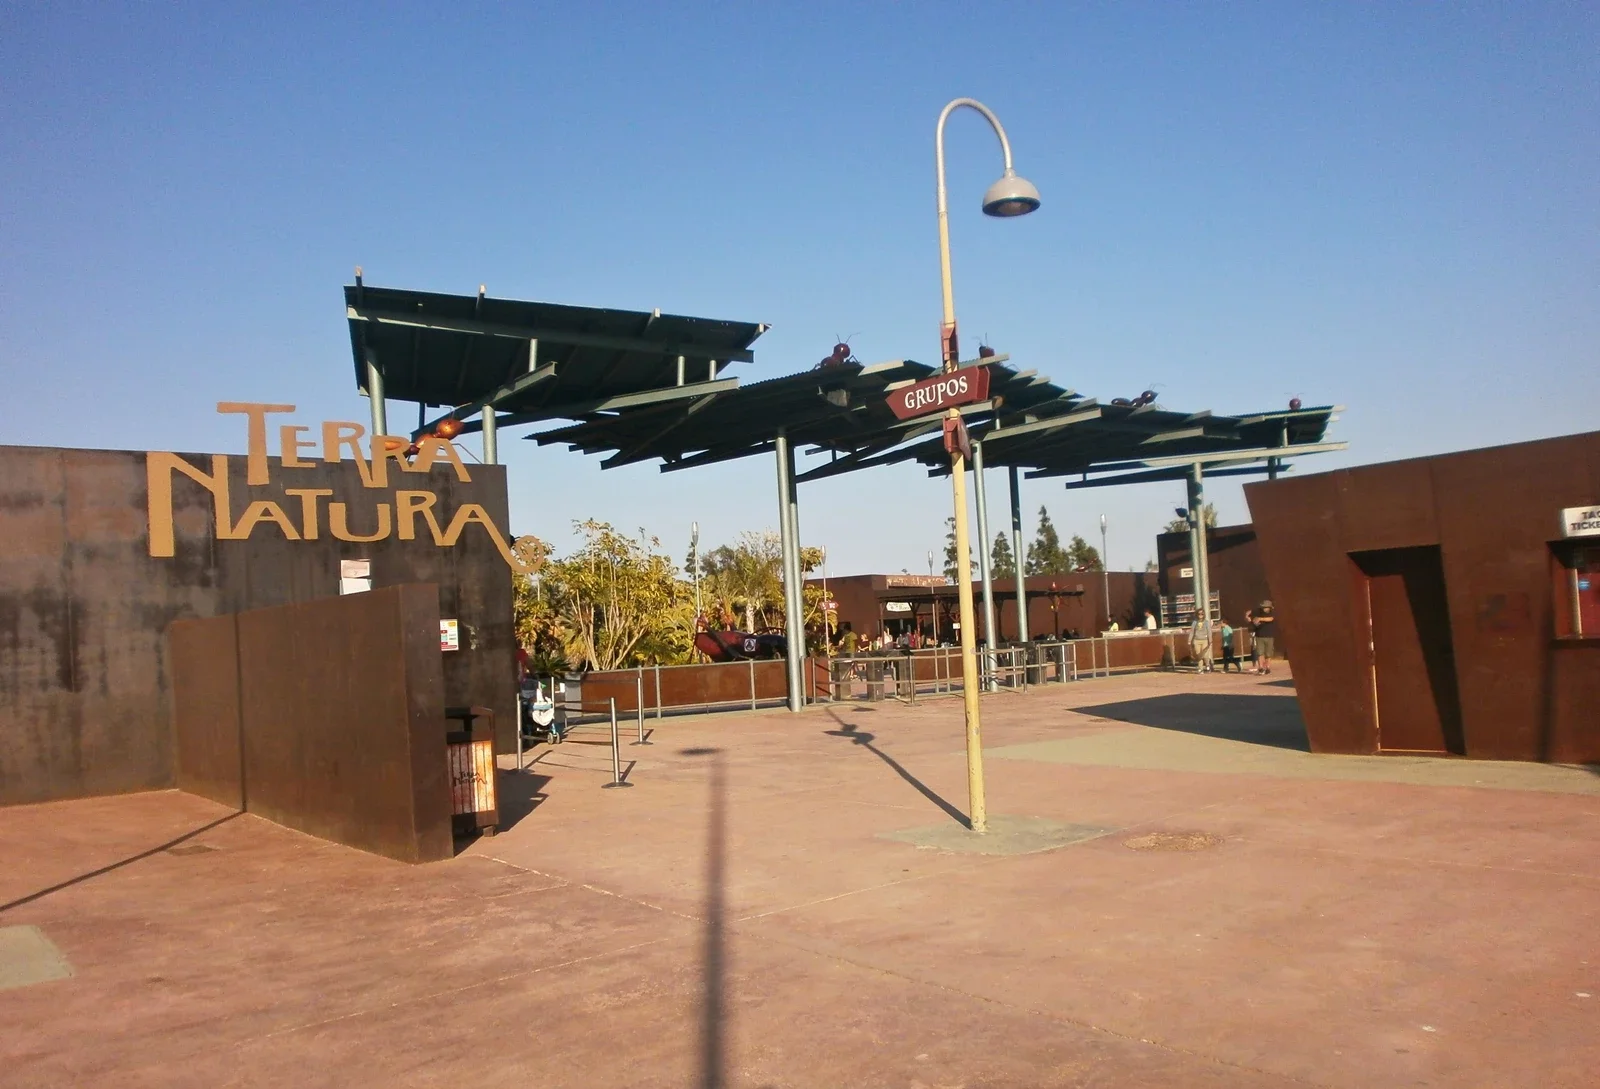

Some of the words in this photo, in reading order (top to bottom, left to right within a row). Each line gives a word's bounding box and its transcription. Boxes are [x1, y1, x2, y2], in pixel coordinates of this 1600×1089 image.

[904, 375, 968, 410] GRUPOS
[216, 401, 472, 488] TERRA
[146, 451, 544, 574] NATURA
